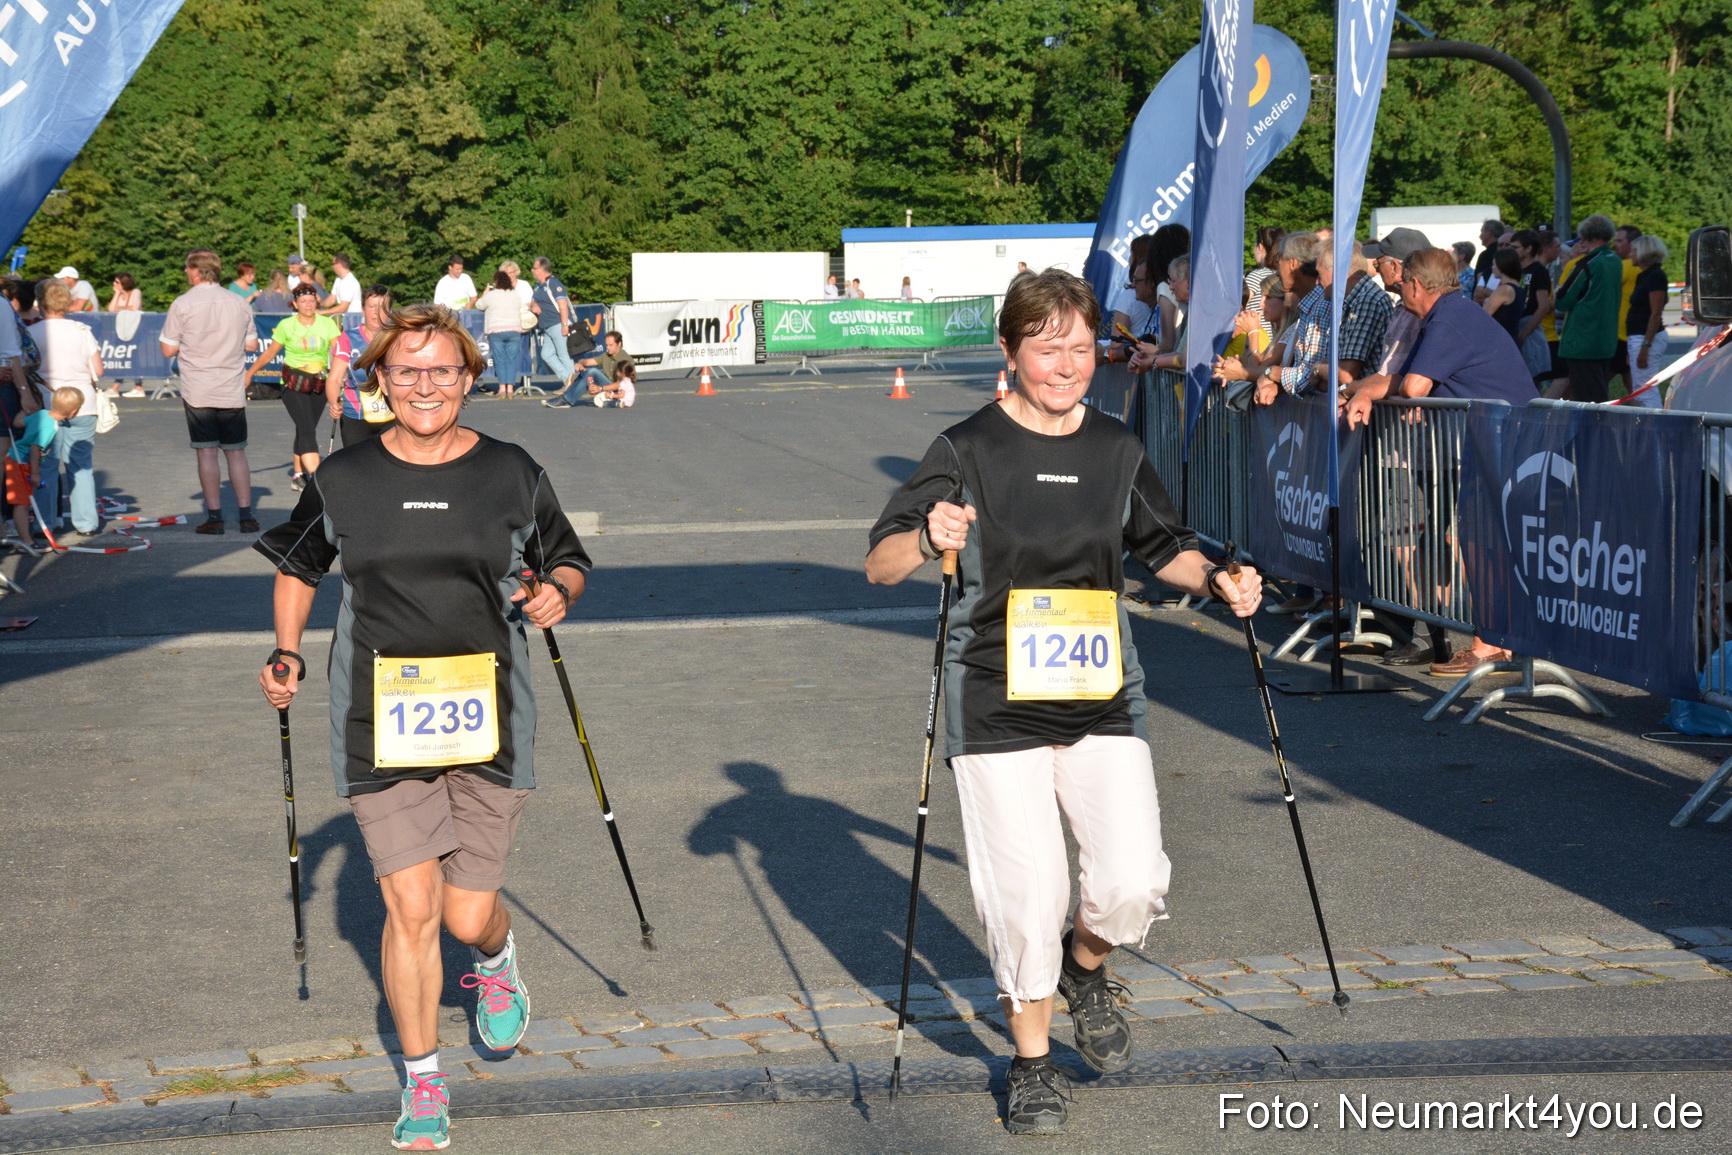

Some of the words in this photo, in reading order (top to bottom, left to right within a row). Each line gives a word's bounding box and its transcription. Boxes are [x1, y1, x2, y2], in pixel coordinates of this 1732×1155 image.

[1254, 92, 1297, 137] Medien
[774, 309, 816, 335] AOK
[828, 310, 914, 325] GESUNDHEIT
[944, 305, 988, 330] AOK
[667, 317, 721, 347] swn
[850, 325, 879, 337] BESTEN
[881, 324, 925, 337] HÄNDEN
[707, 346, 738, 357] neumarkt
[1274, 469, 1330, 531] Fischer
[1522, 514, 1647, 597] Fischer
[1536, 595, 1640, 642] AUTOMOBILE
[1021, 633, 1110, 669] 1240
[393, 676, 437, 686] firmenlauf
[1069, 676, 1088, 684] Frank
[381, 688, 416, 698] walken
[388, 698, 484, 736] 1239
[413, 743, 432, 751] Gabi
[433, 742, 461, 751] Jarosch
